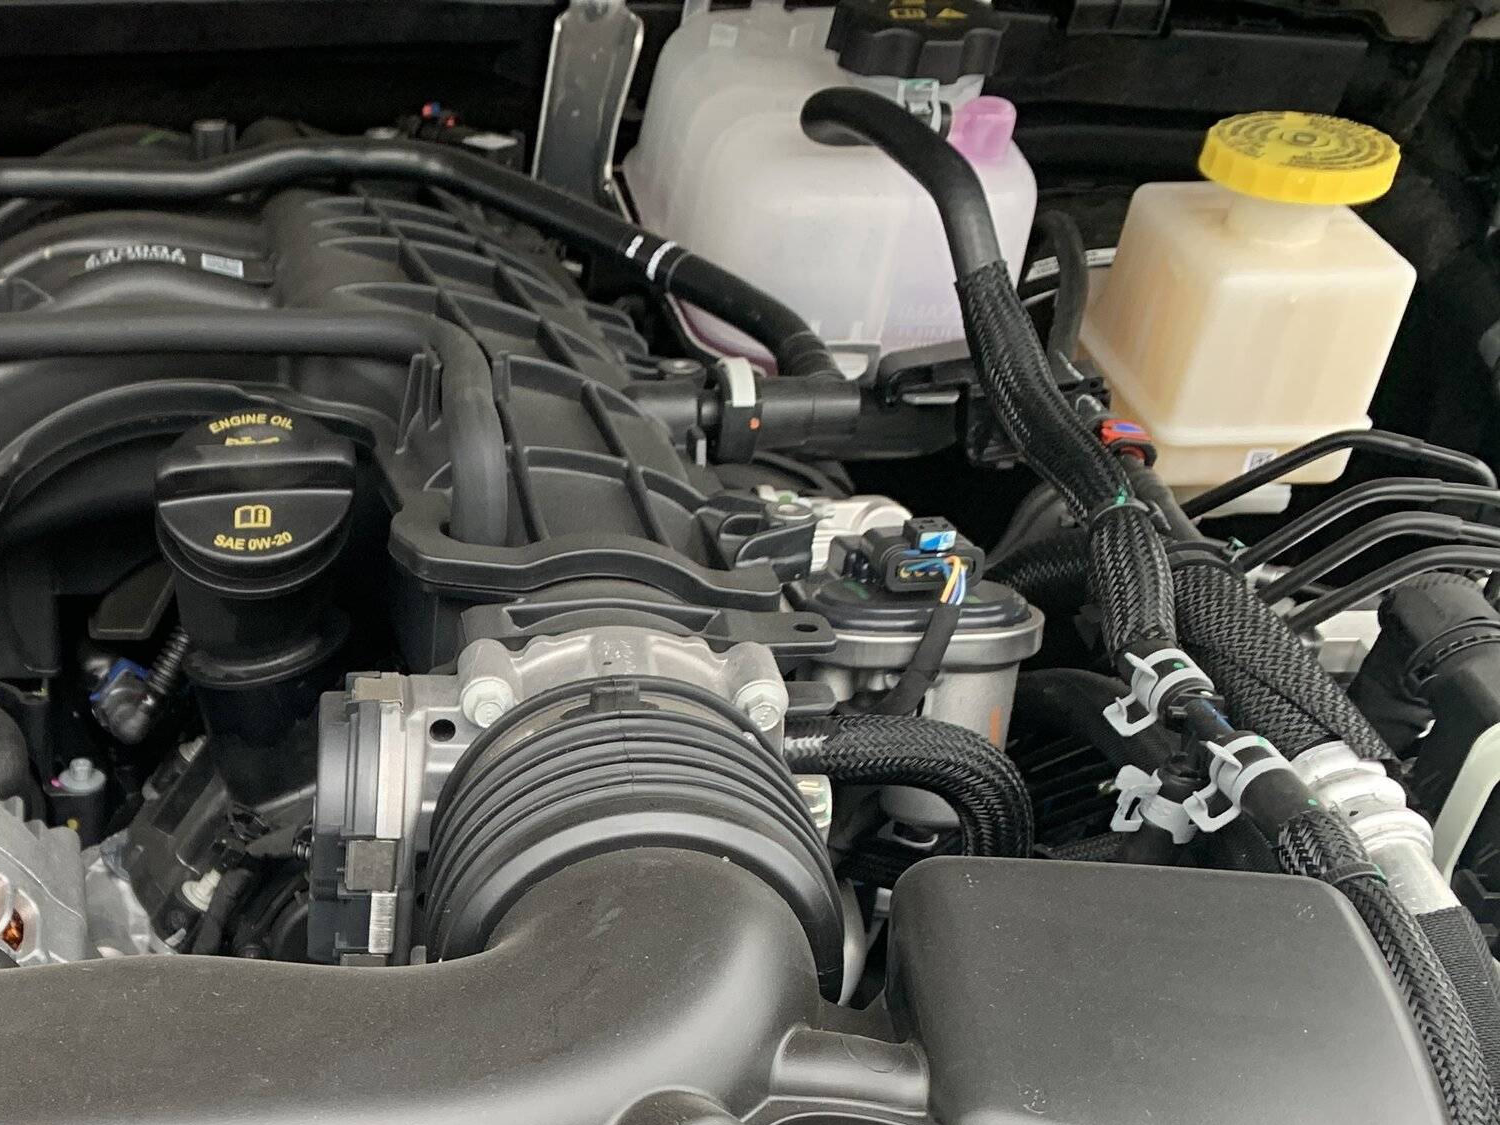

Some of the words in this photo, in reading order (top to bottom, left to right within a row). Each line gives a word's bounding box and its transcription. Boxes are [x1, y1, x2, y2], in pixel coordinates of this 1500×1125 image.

[208, 413, 267, 434] ENGINE
[270, 415, 294, 430] OIL
[213, 534, 245, 550] SAE
[249, 531, 292, 550] 0W-20
